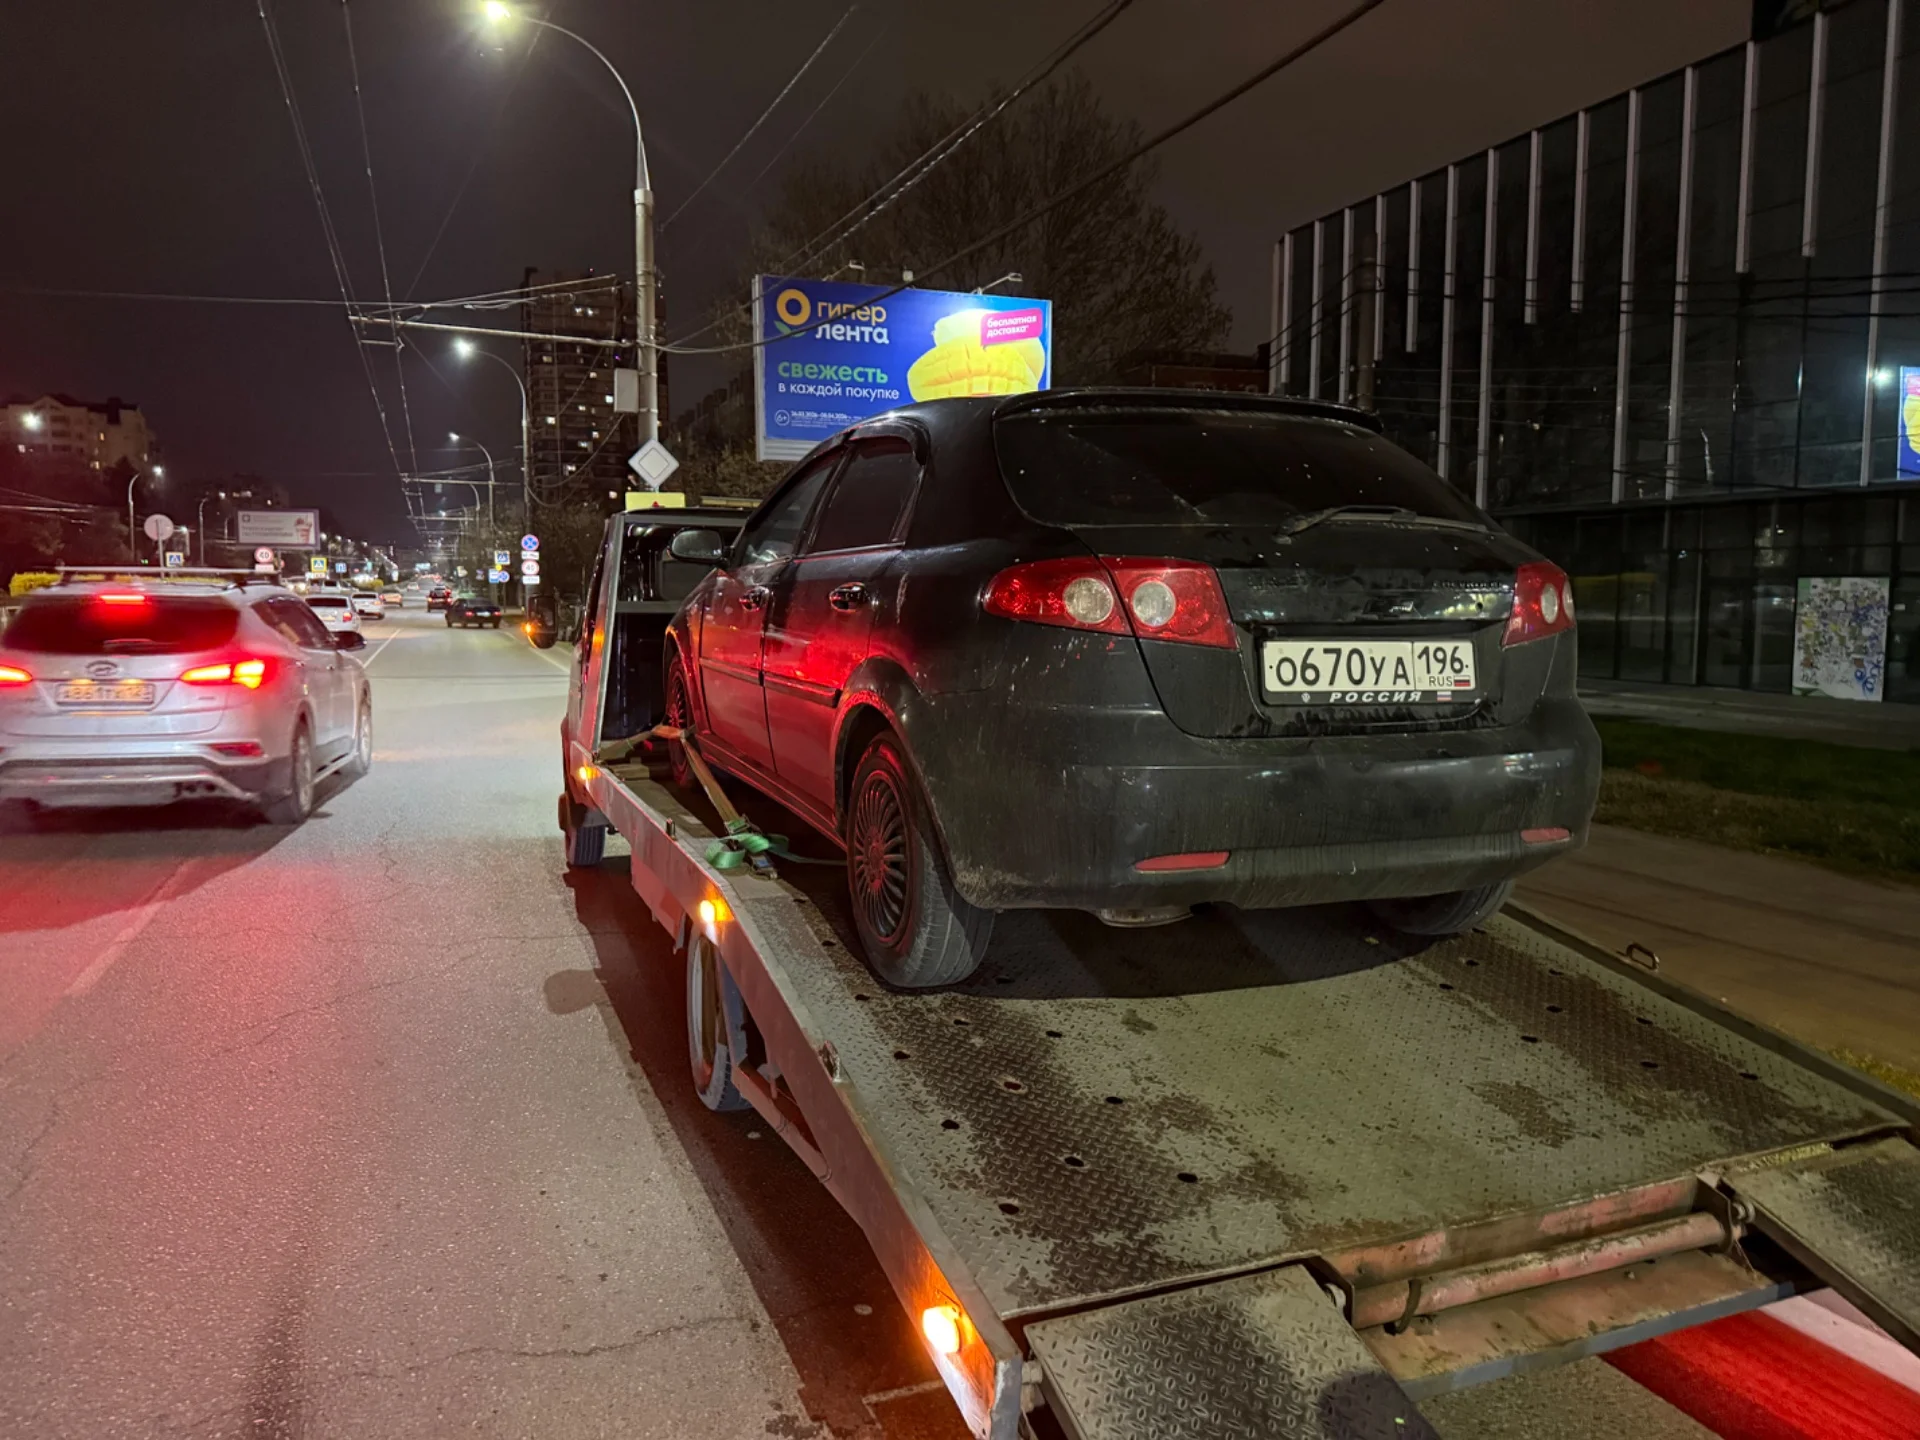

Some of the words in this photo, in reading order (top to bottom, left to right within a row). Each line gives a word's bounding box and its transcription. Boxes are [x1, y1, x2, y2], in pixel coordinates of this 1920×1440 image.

[817, 301, 887, 326] гипер
[987, 315, 1037, 328] бесплатная
[815, 322, 890, 344] лента
[777, 361, 889, 384] свежесть
[778, 383, 786, 393] в
[790, 381, 842, 397] каждой
[846, 386, 900, 402] покупке
[1275, 647, 1411, 686] О670УА
[1416, 645, 1465, 675] 196
[1428, 676, 1453, 687] RUS
[1329, 691, 1423, 703] РОССИЯ
